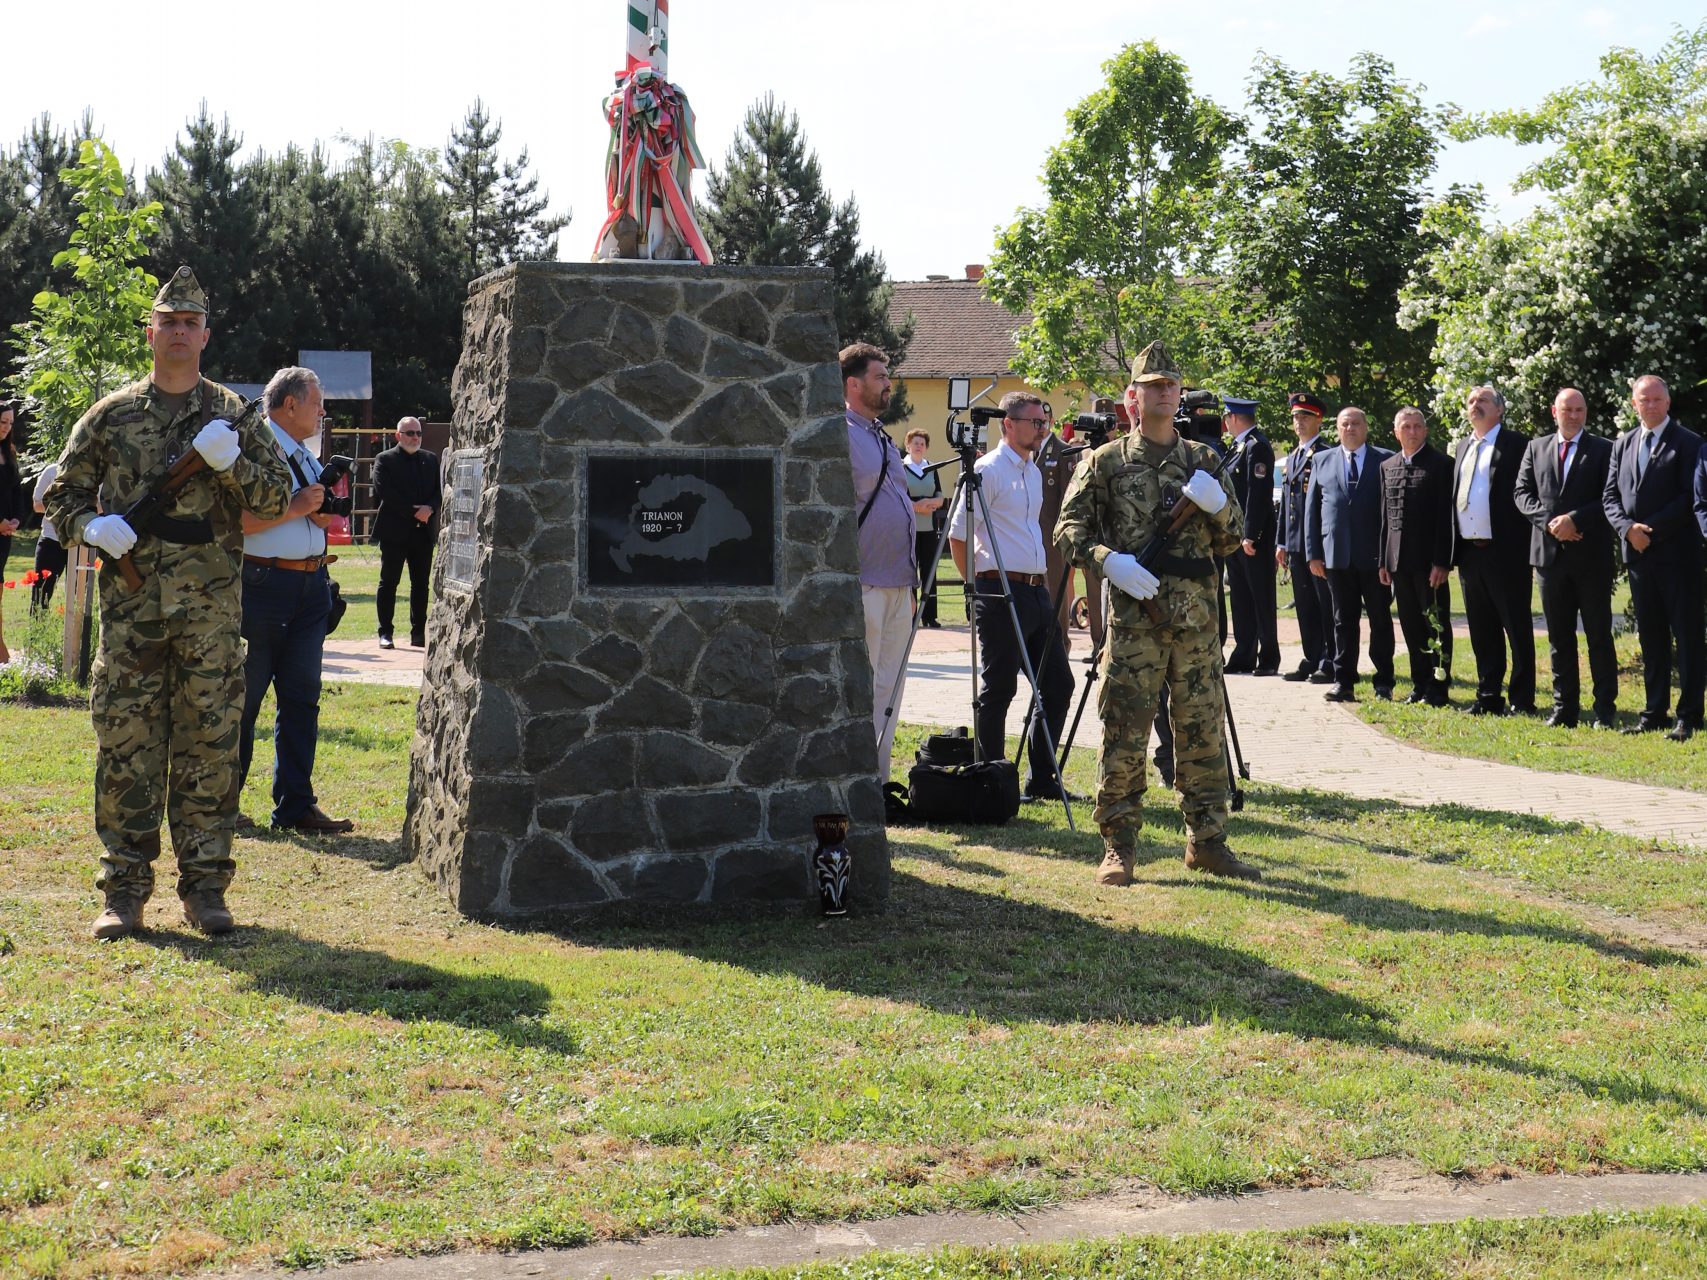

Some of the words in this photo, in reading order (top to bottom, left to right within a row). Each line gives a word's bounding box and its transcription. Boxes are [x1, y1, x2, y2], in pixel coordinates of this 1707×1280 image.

[641, 511, 683, 521] TRIANON
[641, 523, 662, 533] 1920
[676, 523, 682, 532] ?
